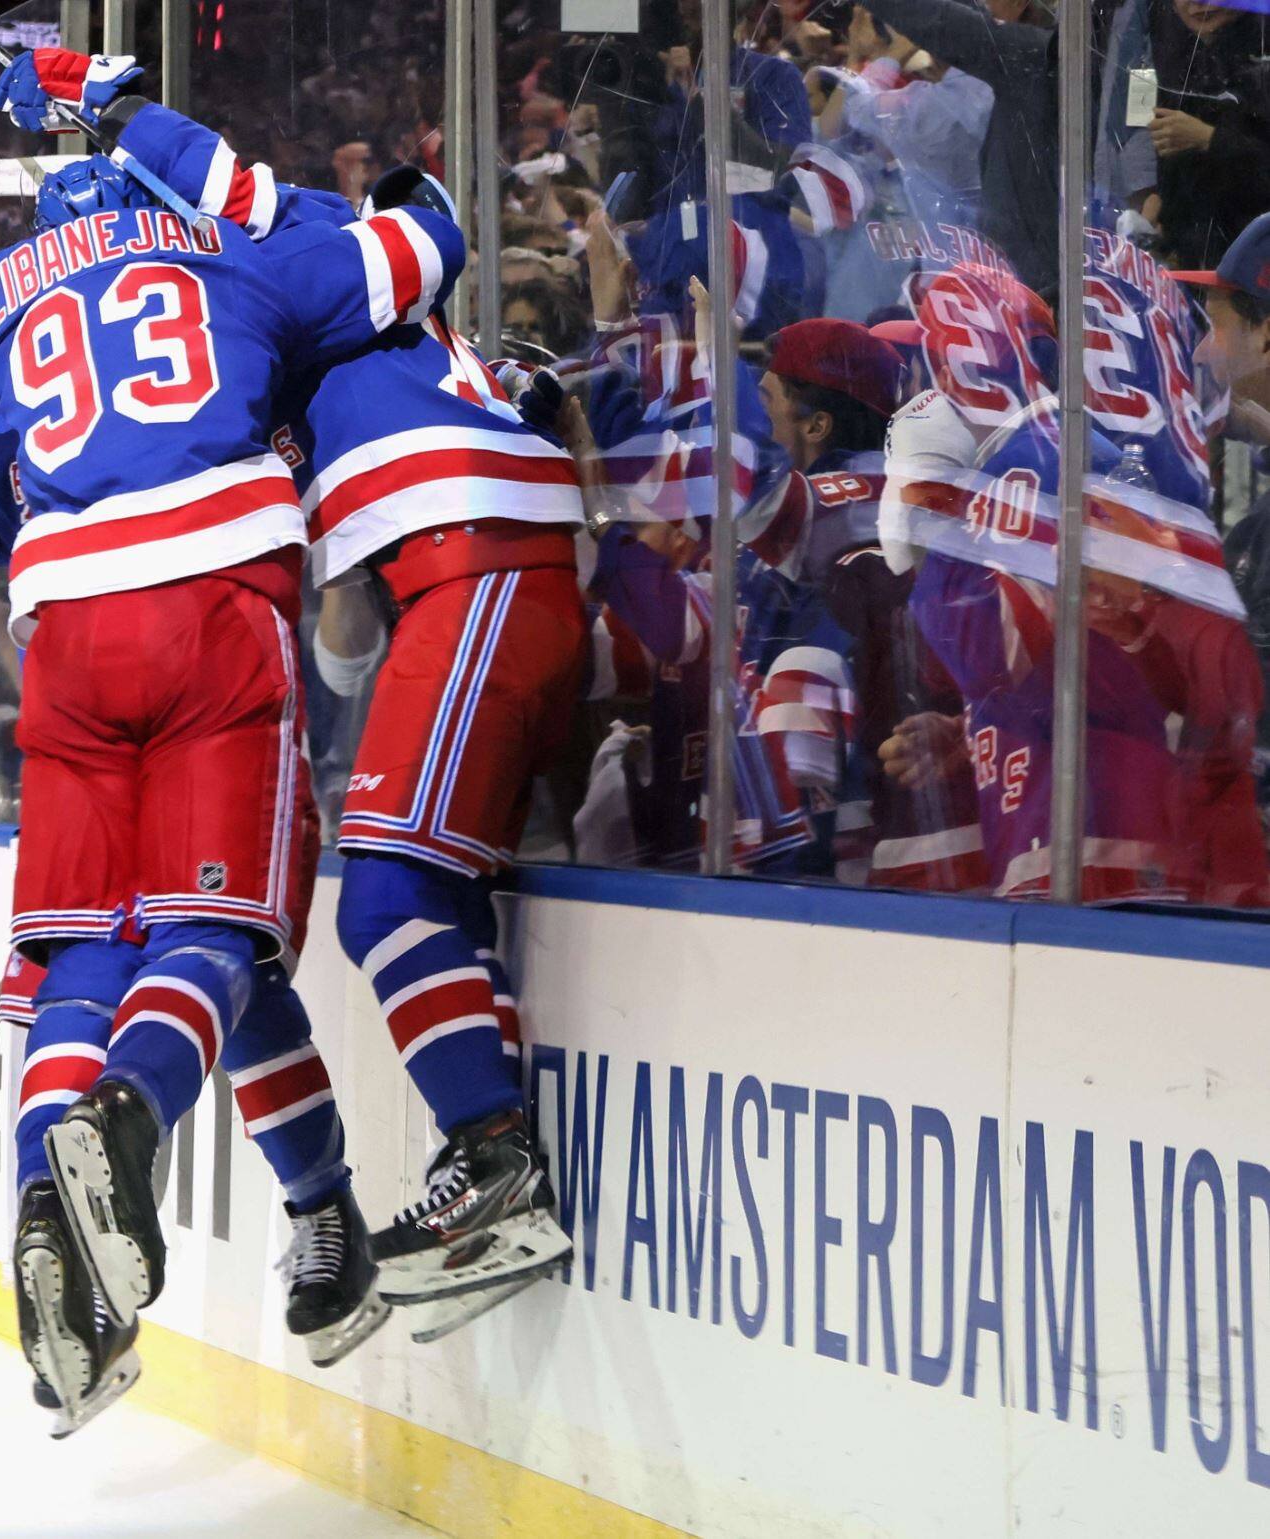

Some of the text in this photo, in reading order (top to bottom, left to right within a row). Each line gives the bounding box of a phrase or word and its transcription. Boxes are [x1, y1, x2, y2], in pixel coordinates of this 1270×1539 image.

[10, 262, 218, 474] 93
[622, 1061, 1099, 1431] AMSTERDAM
[1130, 1140, 1270, 1490] VOD
